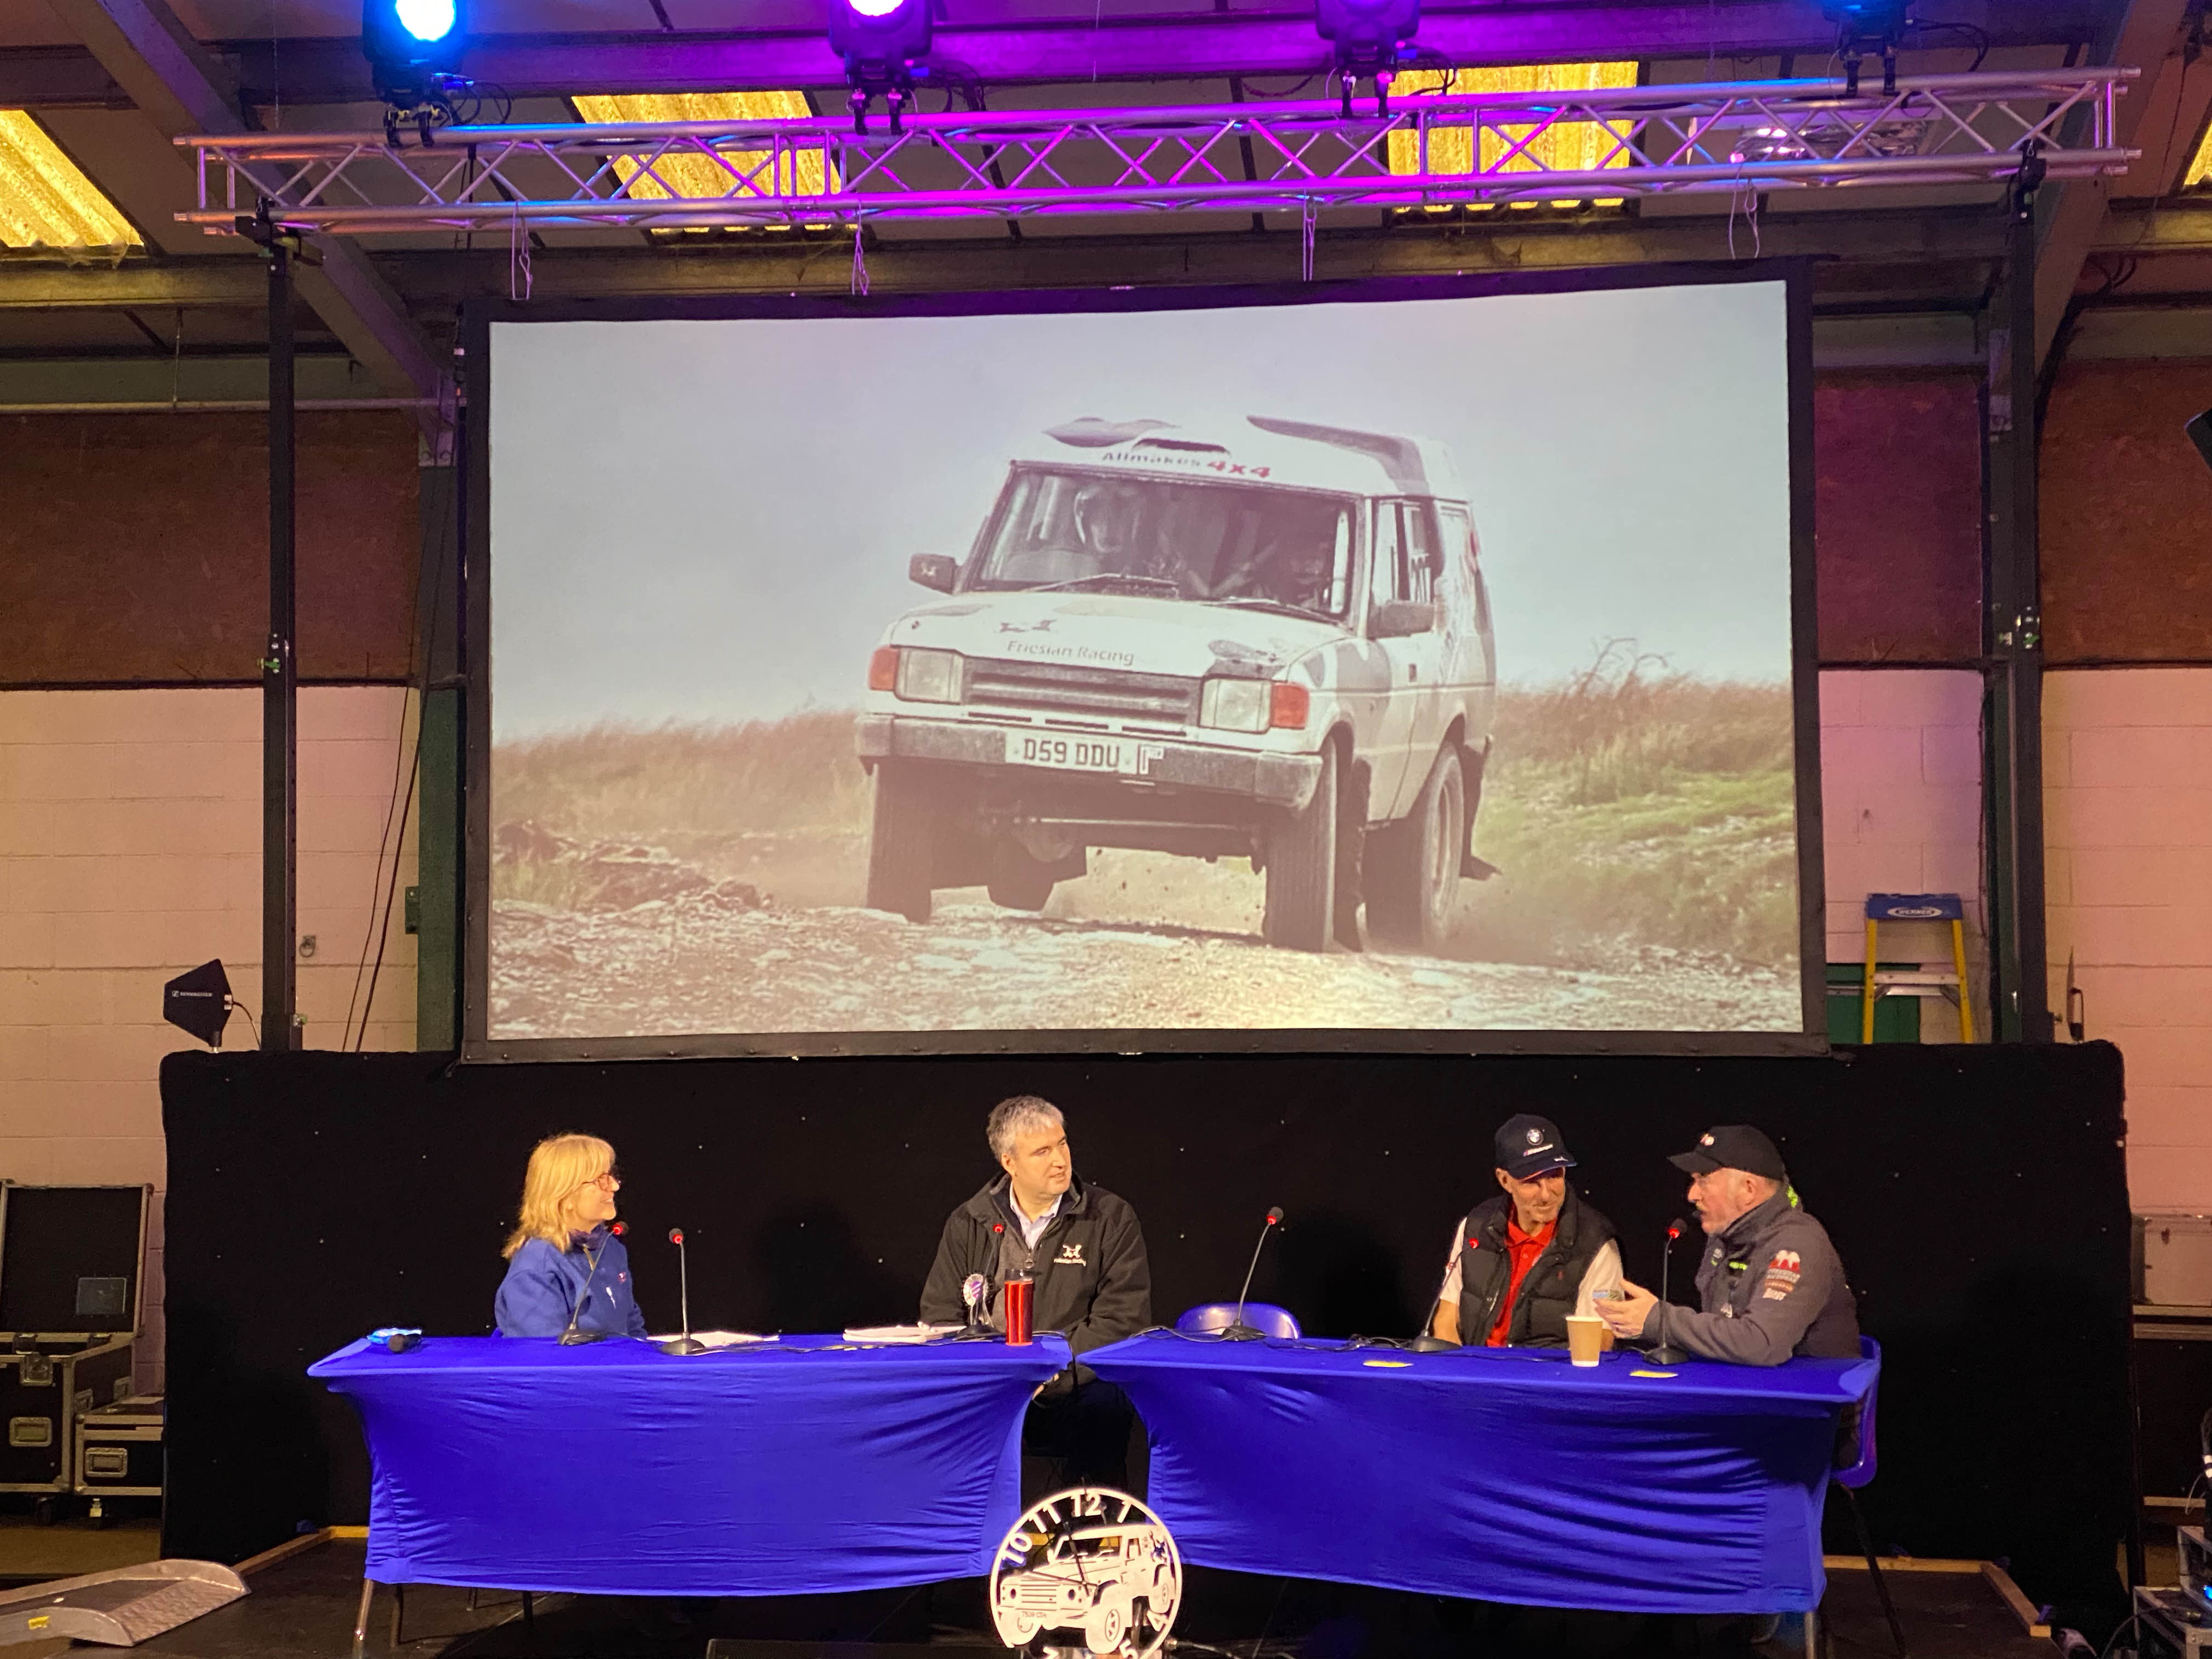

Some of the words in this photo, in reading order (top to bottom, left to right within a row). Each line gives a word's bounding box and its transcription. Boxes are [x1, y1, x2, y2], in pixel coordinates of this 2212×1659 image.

[1102, 452, 1201, 467] Allmakes
[1208, 460, 1271, 479] 4x4
[1007, 640, 1072, 657] Friesian
[1077, 646, 1135, 667] Racing
[1024, 738, 1068, 764] D59
[1075, 742, 1120, 768] DDU
[1002, 1532, 1033, 1564] 10
[1028, 1503, 1062, 1534] 11
[1071, 1492, 1102, 1518] 12
